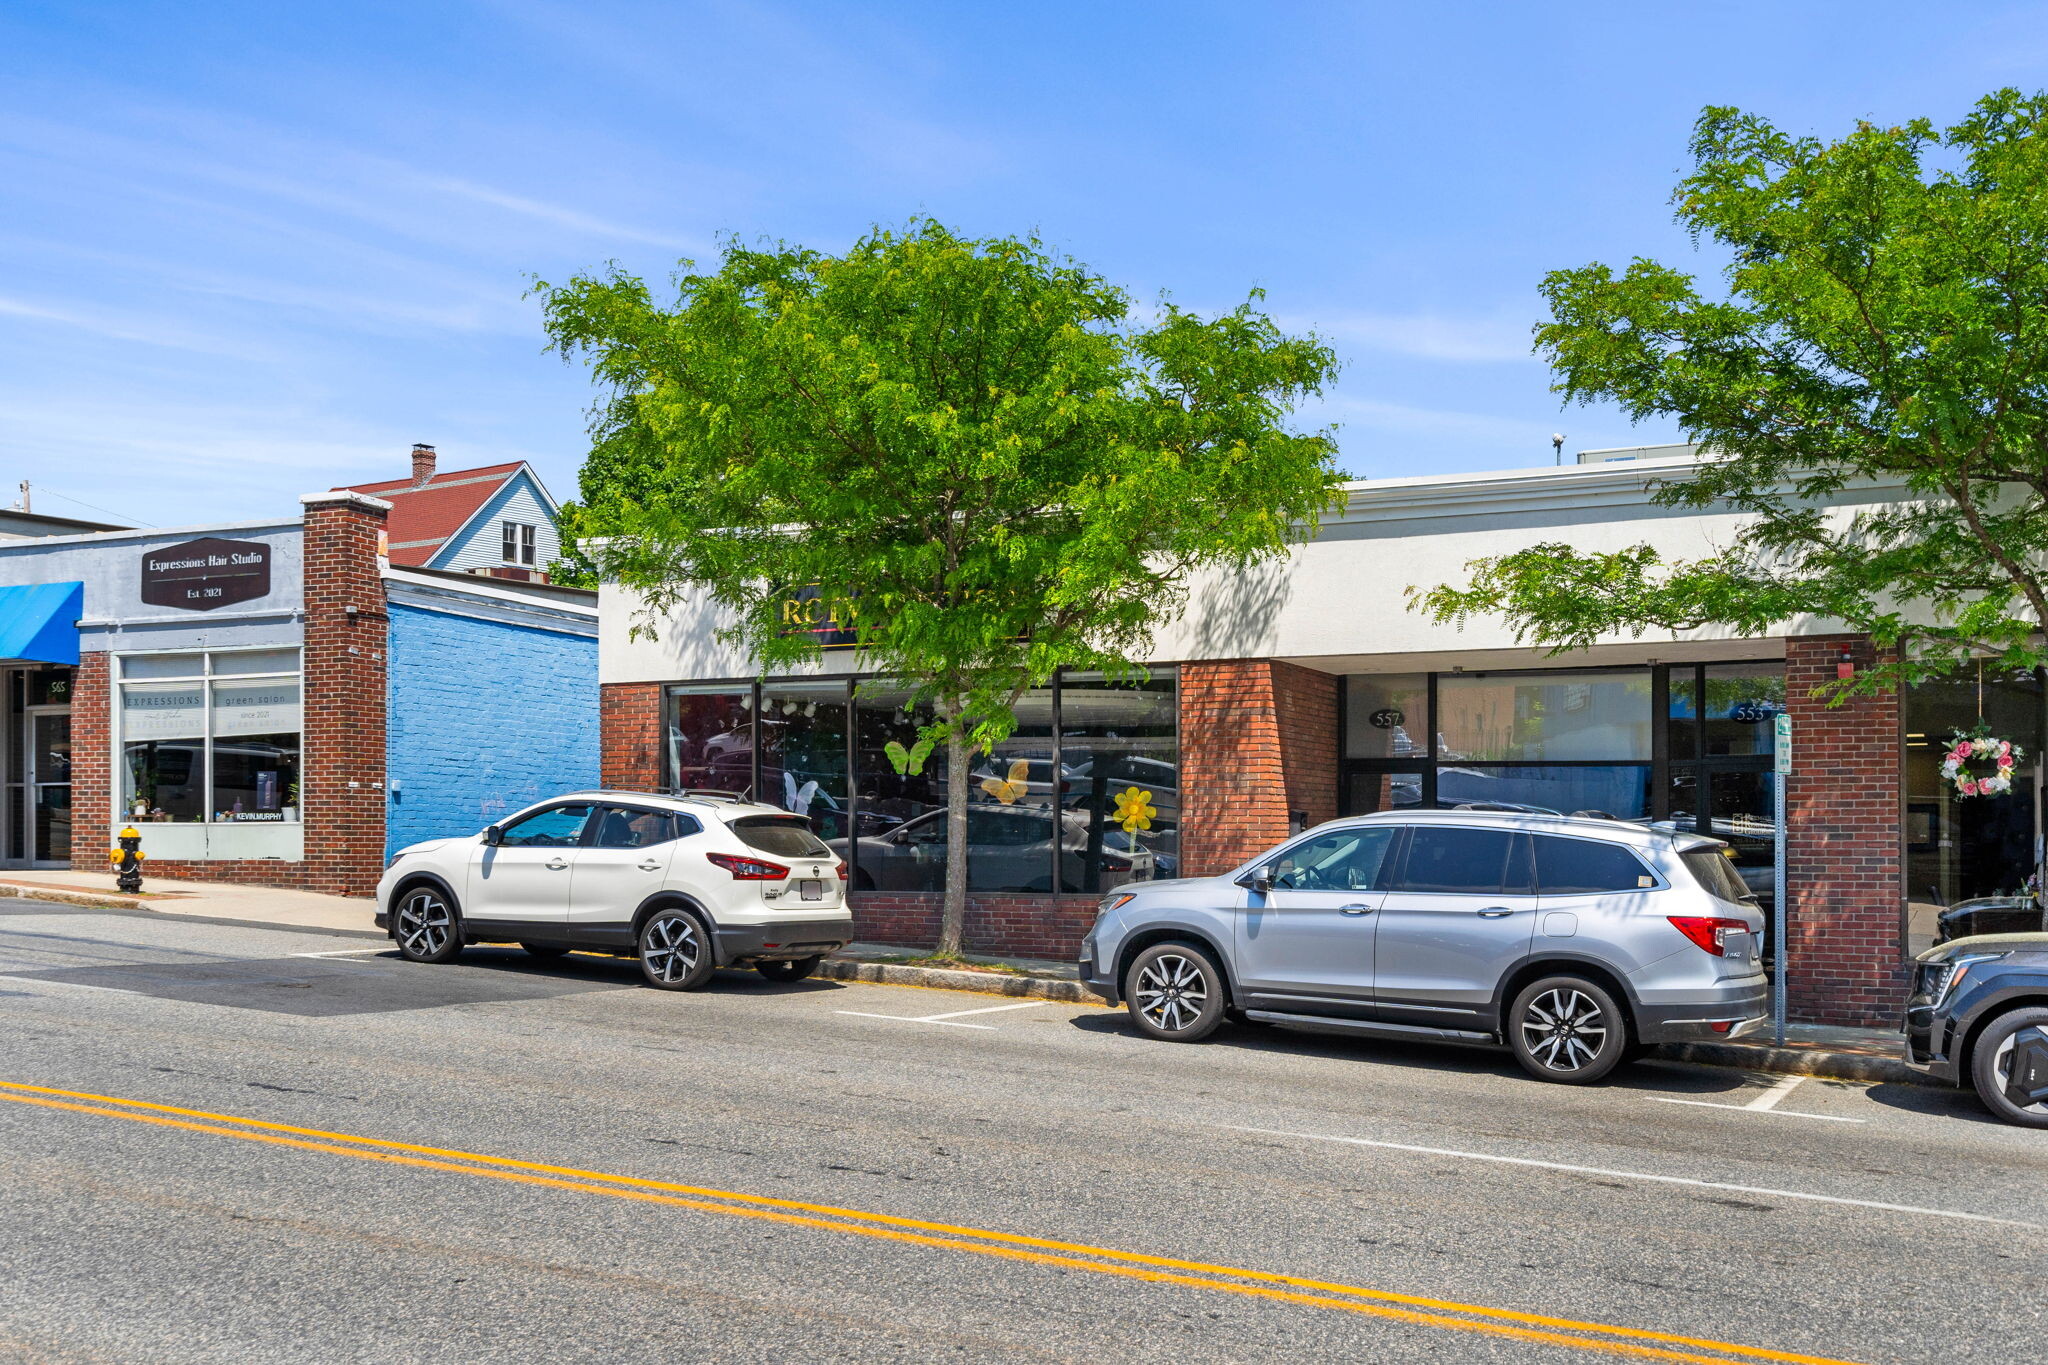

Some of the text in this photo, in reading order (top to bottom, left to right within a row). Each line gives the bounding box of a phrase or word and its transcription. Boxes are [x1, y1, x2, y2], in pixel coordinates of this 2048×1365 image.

[149, 552, 262, 572] Expressions Hair Studio
[203, 588, 222, 598] 2021
[51, 681, 66, 693] 565
[127, 696, 200, 707] EXPRESSIONS
[225, 695, 285, 707] green salon
[1376, 712, 1400, 726] 557
[1736, 707, 1764, 721] 553
